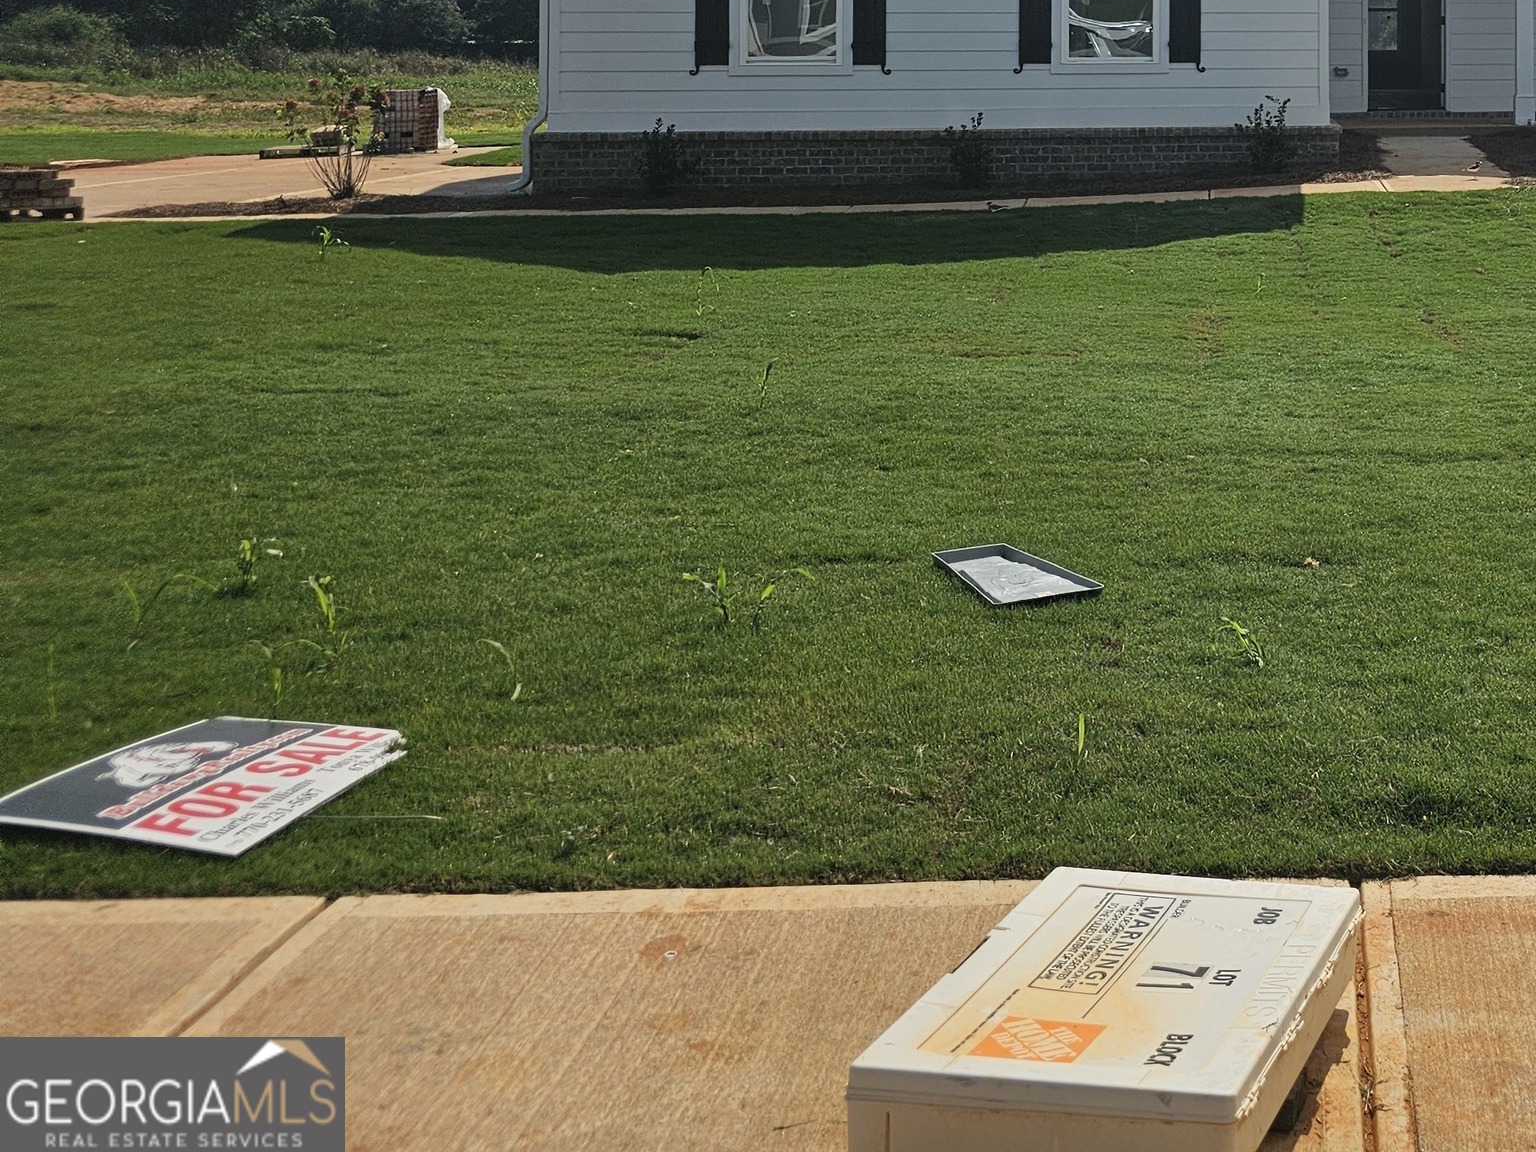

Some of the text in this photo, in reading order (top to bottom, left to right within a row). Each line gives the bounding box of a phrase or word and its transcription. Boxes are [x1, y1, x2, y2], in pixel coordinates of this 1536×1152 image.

[316, 754, 362, 772] Tonya
[132, 780, 277, 837] FOR
[244, 725, 391, 779] SALE
[200, 778, 317, 843] Charles Williams
[235, 787, 324, 840] 770-231-5687
[1170, 899, 1192, 918] BUILDER
[1253, 906, 1283, 925] JOB
[1078, 905, 1164, 986] WARNING!
[1135, 965, 1210, 989] 71
[1209, 969, 1242, 987] LOT
[989, 1031, 1039, 1059] DEPOT
[1001, 1018, 1078, 1061] HOME
[1049, 1025, 1082, 1046] THE
[1143, 1033, 1195, 1067] BLOCK
